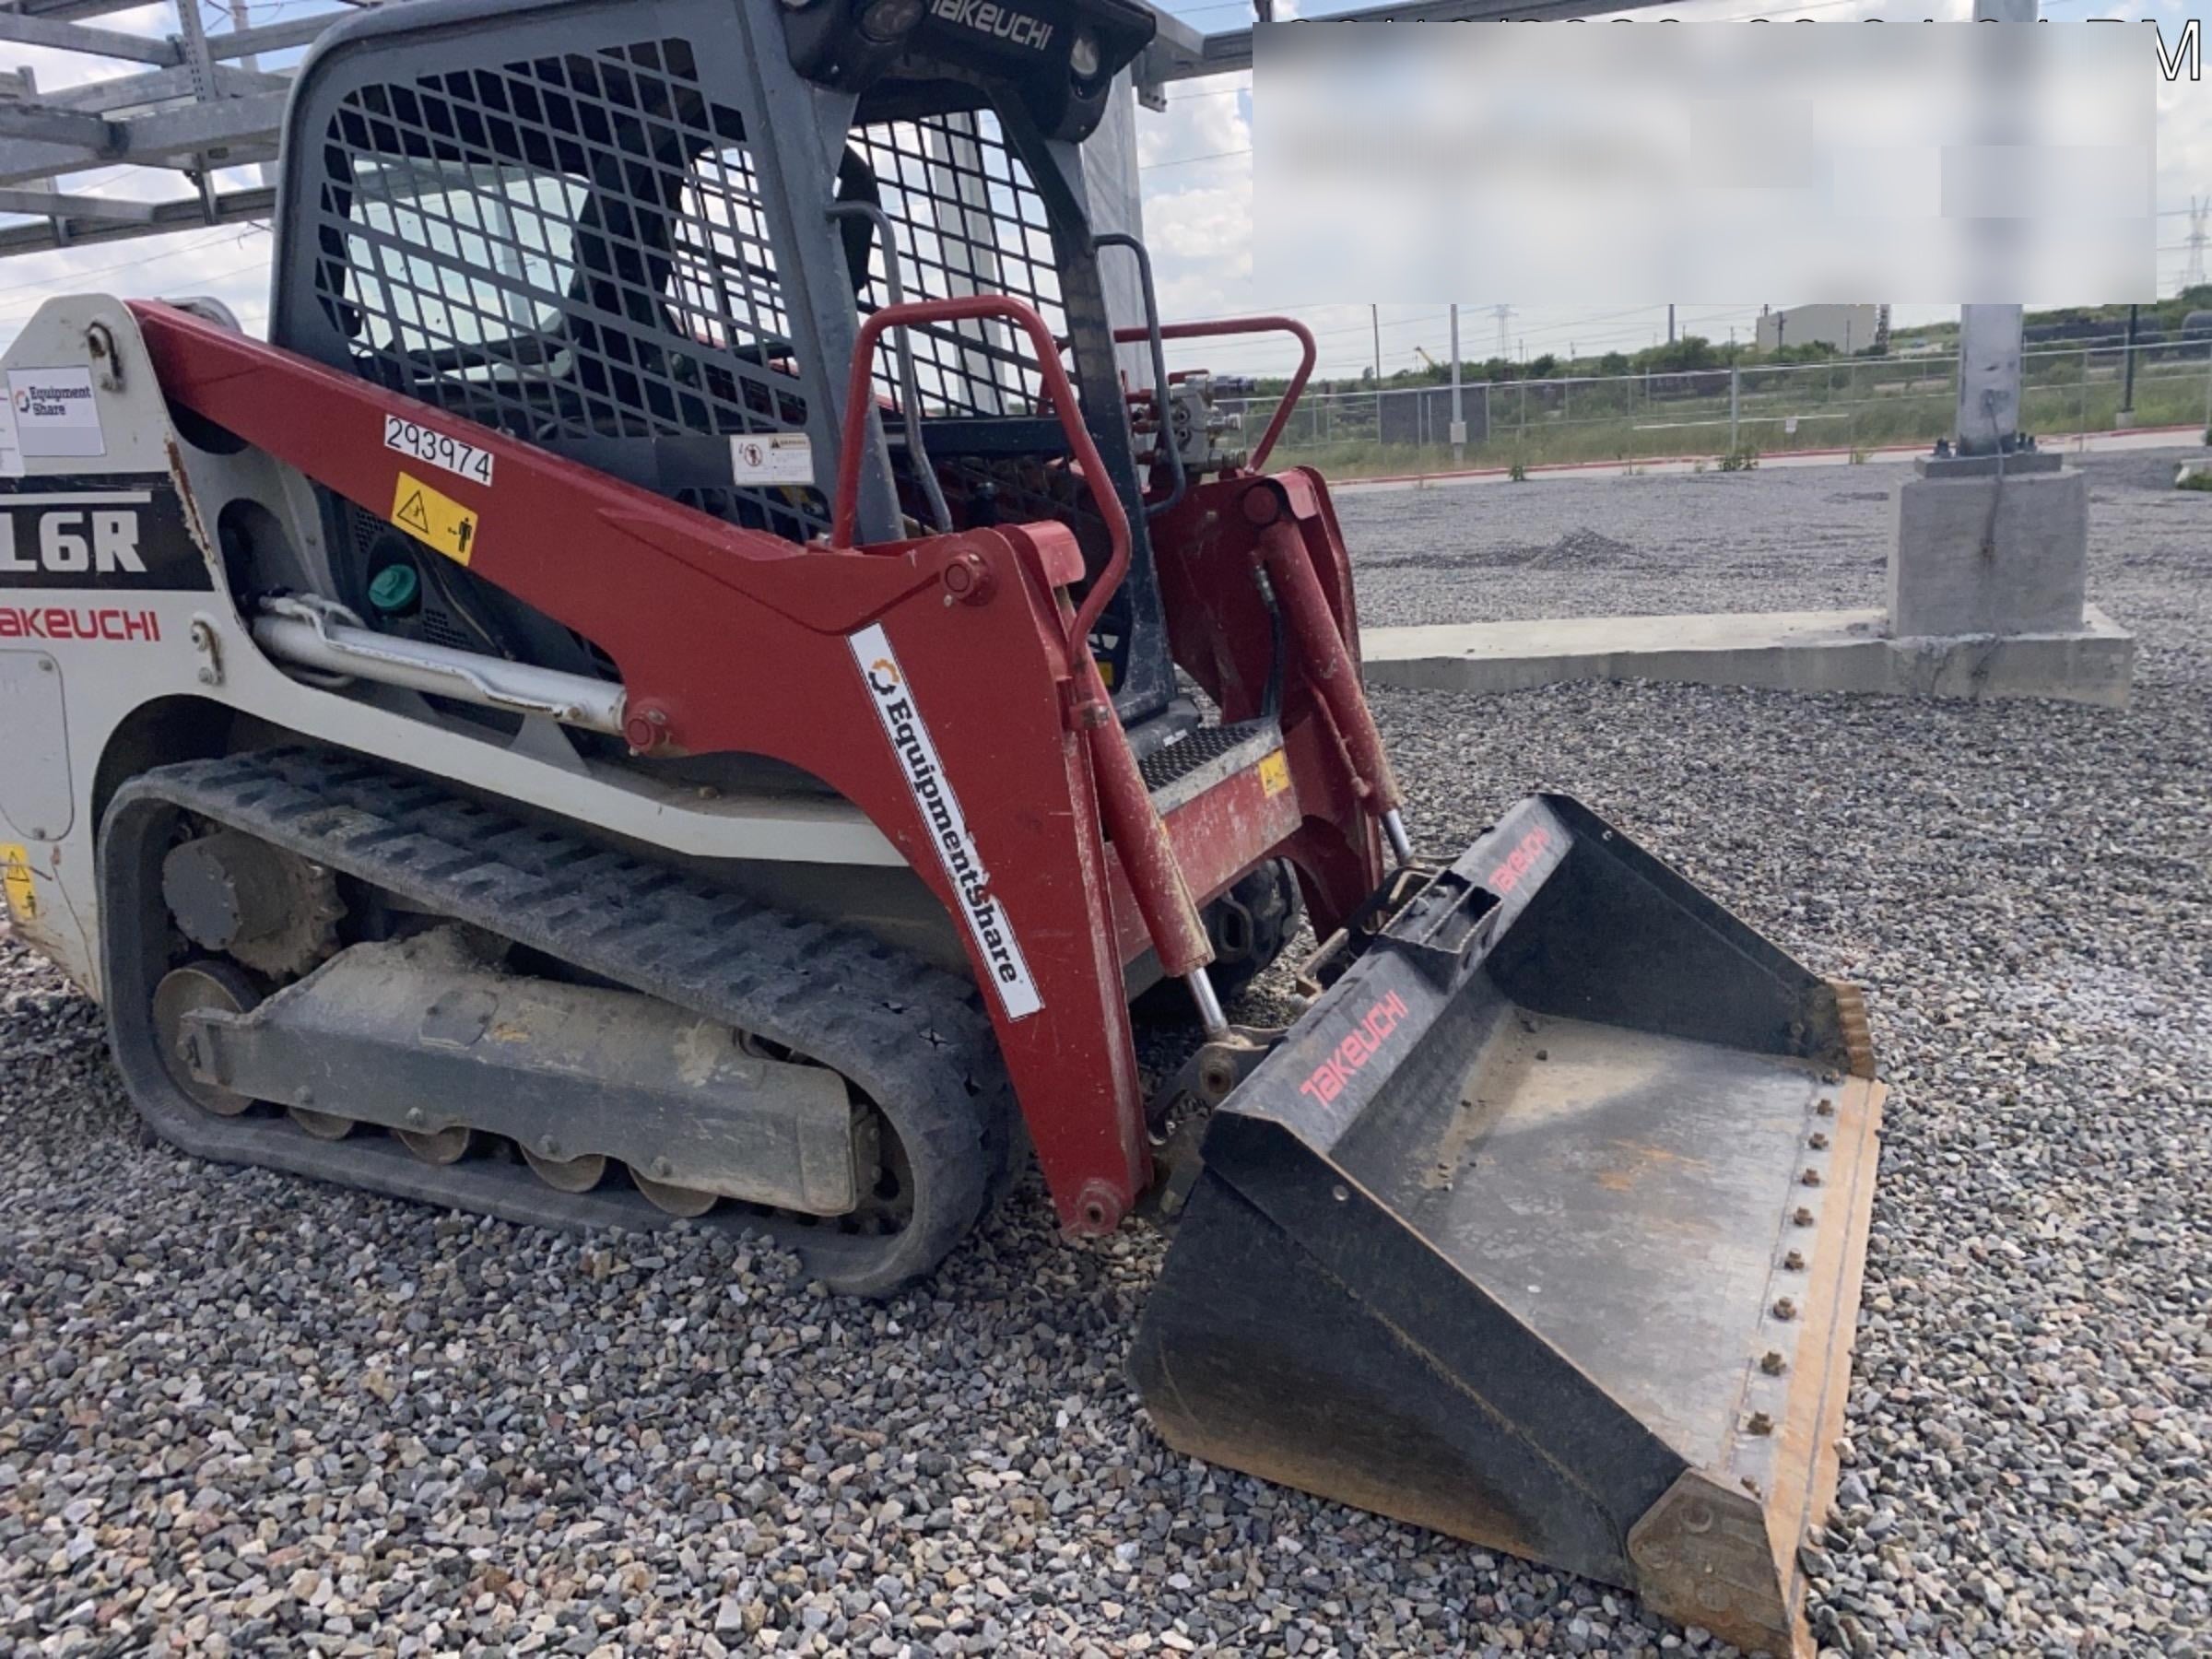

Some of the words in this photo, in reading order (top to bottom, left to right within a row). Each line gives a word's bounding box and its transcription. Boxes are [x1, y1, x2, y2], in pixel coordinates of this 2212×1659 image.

[29, 385, 92, 403] Equipment
[32, 402, 66, 416] Share
[387, 418, 490, 481] 293974
